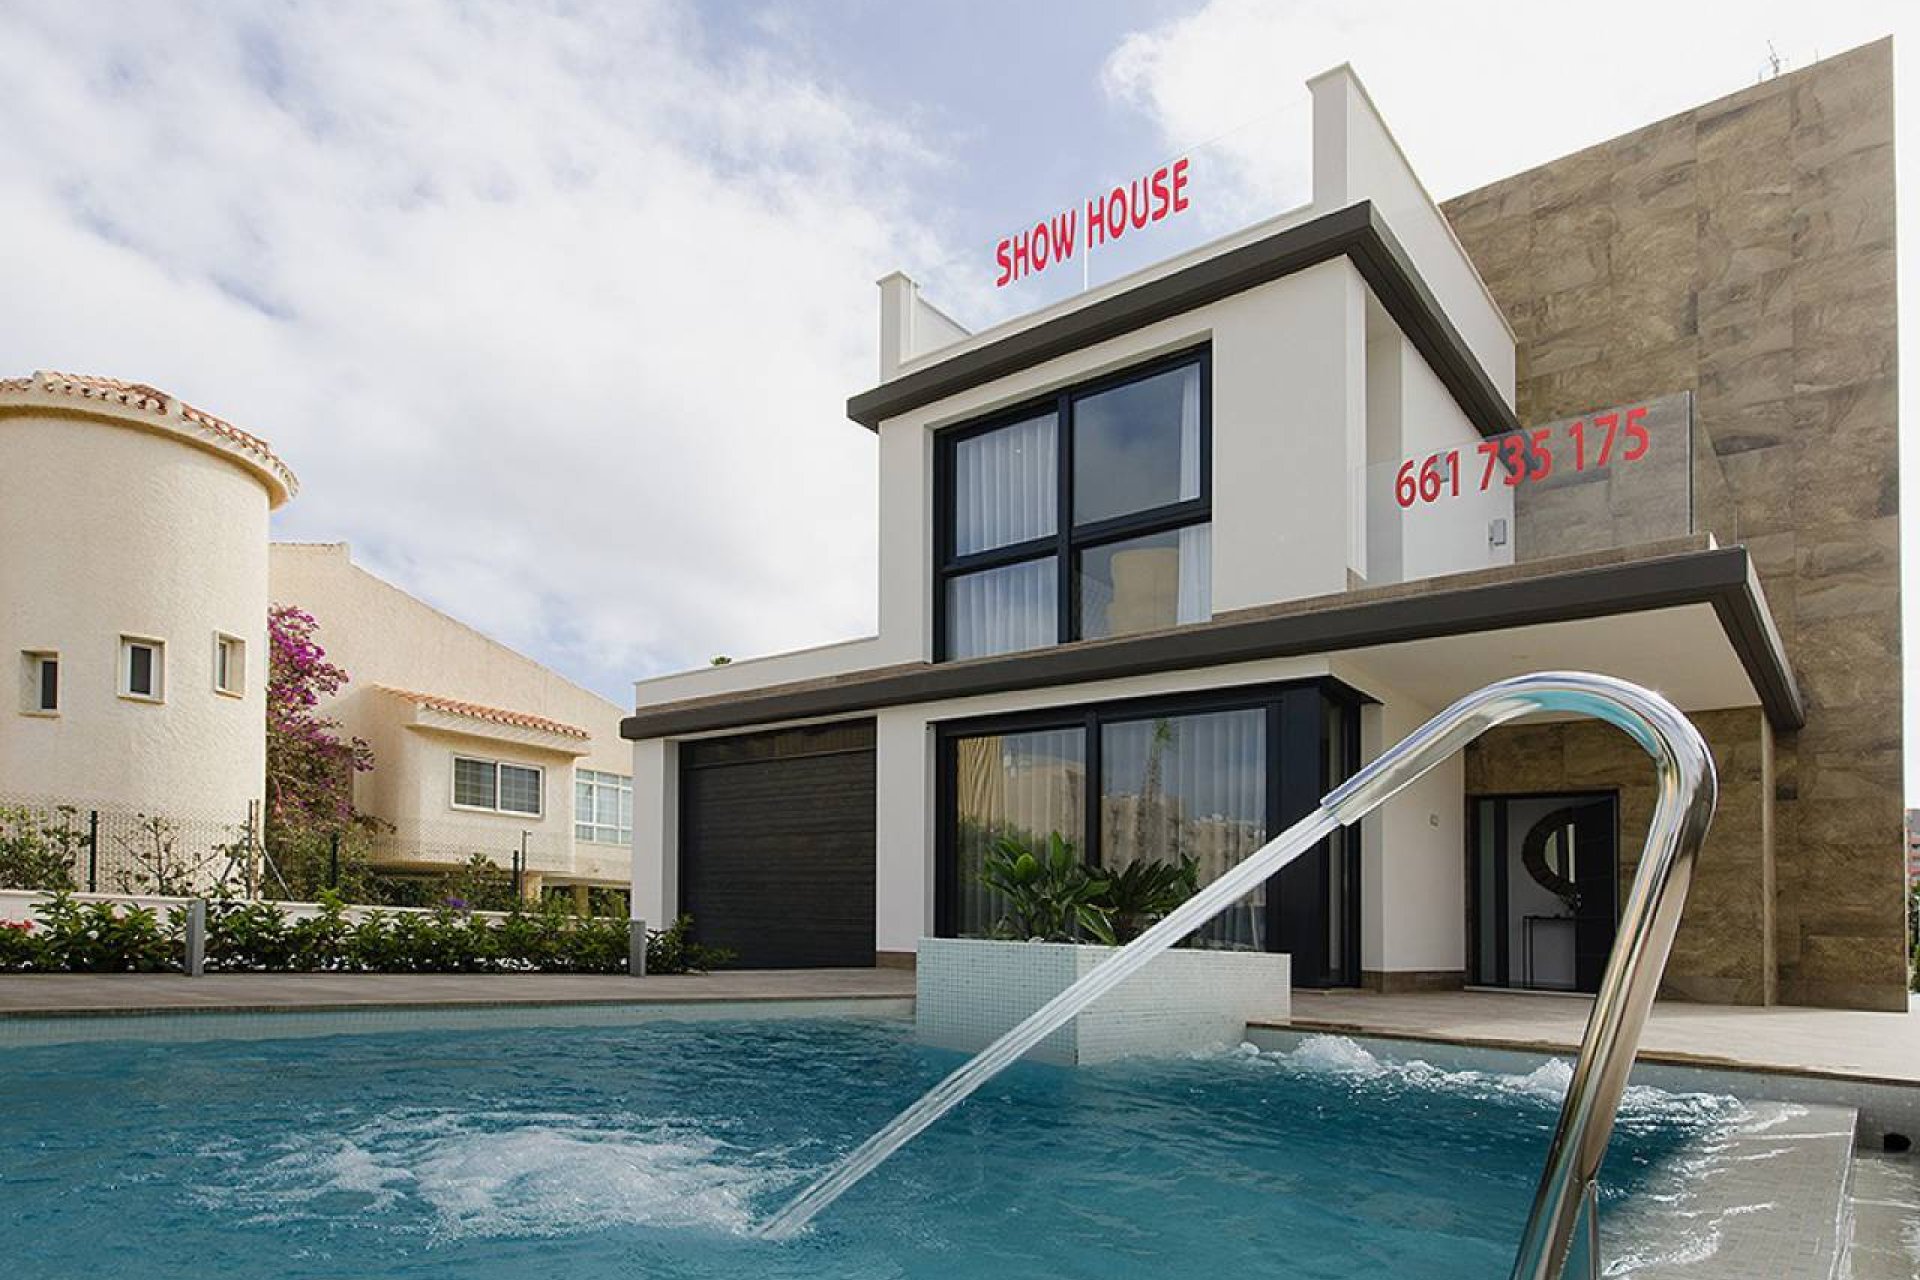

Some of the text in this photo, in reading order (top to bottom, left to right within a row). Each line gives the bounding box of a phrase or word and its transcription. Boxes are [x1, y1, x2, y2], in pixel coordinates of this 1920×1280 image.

[996, 157, 1189, 287] SHOW HOUSE
[1395, 406, 1650, 508] 661 735 175
